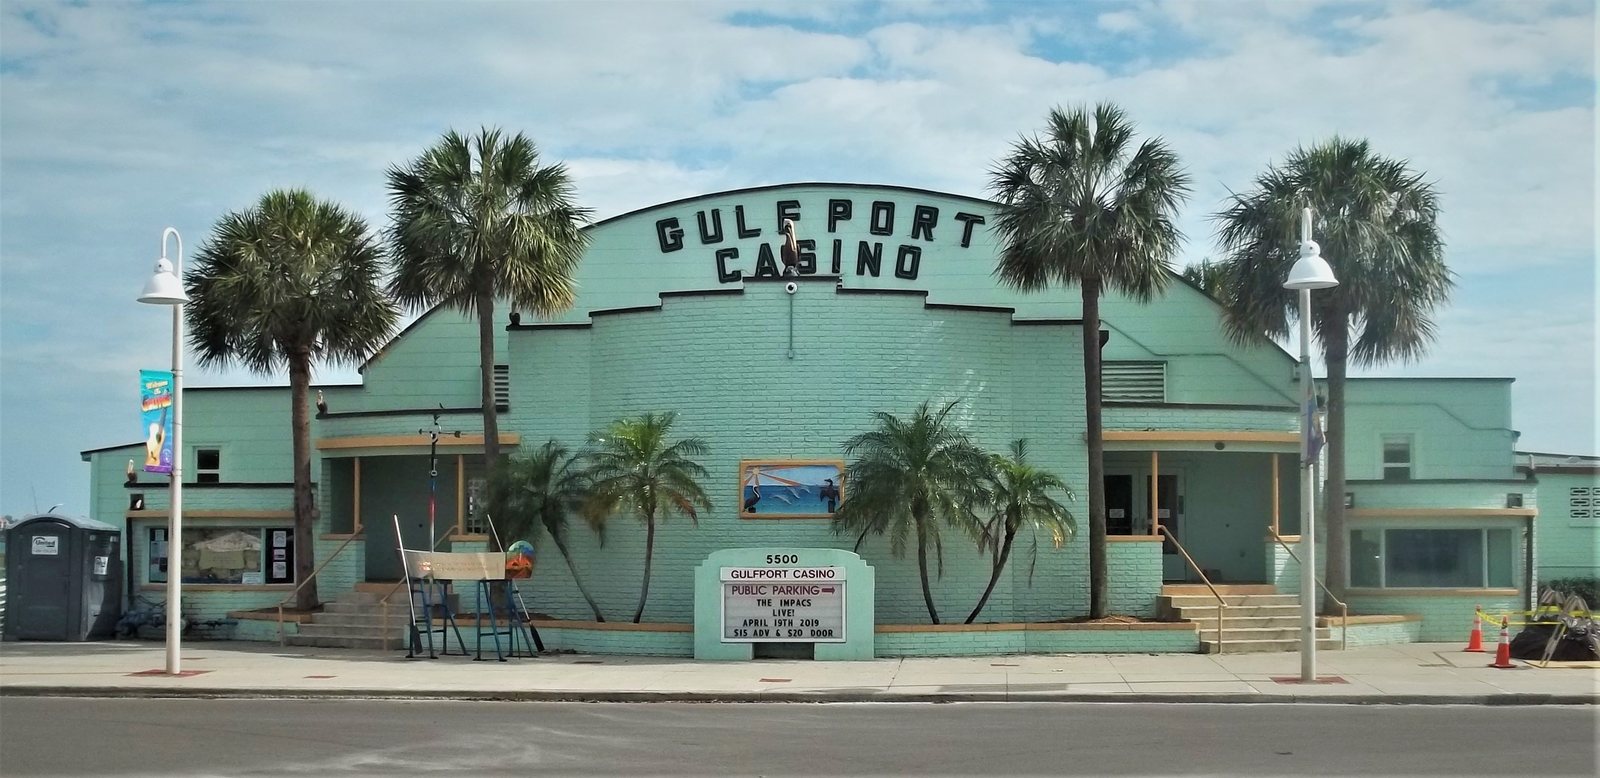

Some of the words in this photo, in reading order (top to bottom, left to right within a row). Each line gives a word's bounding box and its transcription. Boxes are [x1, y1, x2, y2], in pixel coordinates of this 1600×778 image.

[656, 199, 985, 253] GULFPORT
[715, 239, 921, 283] CASINO
[766, 554, 798, 564] 5500
[731, 569, 788, 579] GULFPORT
[793, 569, 835, 579] CASINO
[731, 585, 767, 595] PUBLIC
[772, 585, 820, 595] PARKING
[757, 599, 772, 607] THE
[779, 599, 812, 607] IMPACS
[772, 609, 795, 617] LIVE!
[743, 619, 768, 627] APRIL
[774, 619, 793, 627] 19TH
[800, 619, 820, 627] 2019
[753, 629, 770, 637] ADV
[775, 629, 781, 637] &
[810, 629, 833, 637] DOOR
